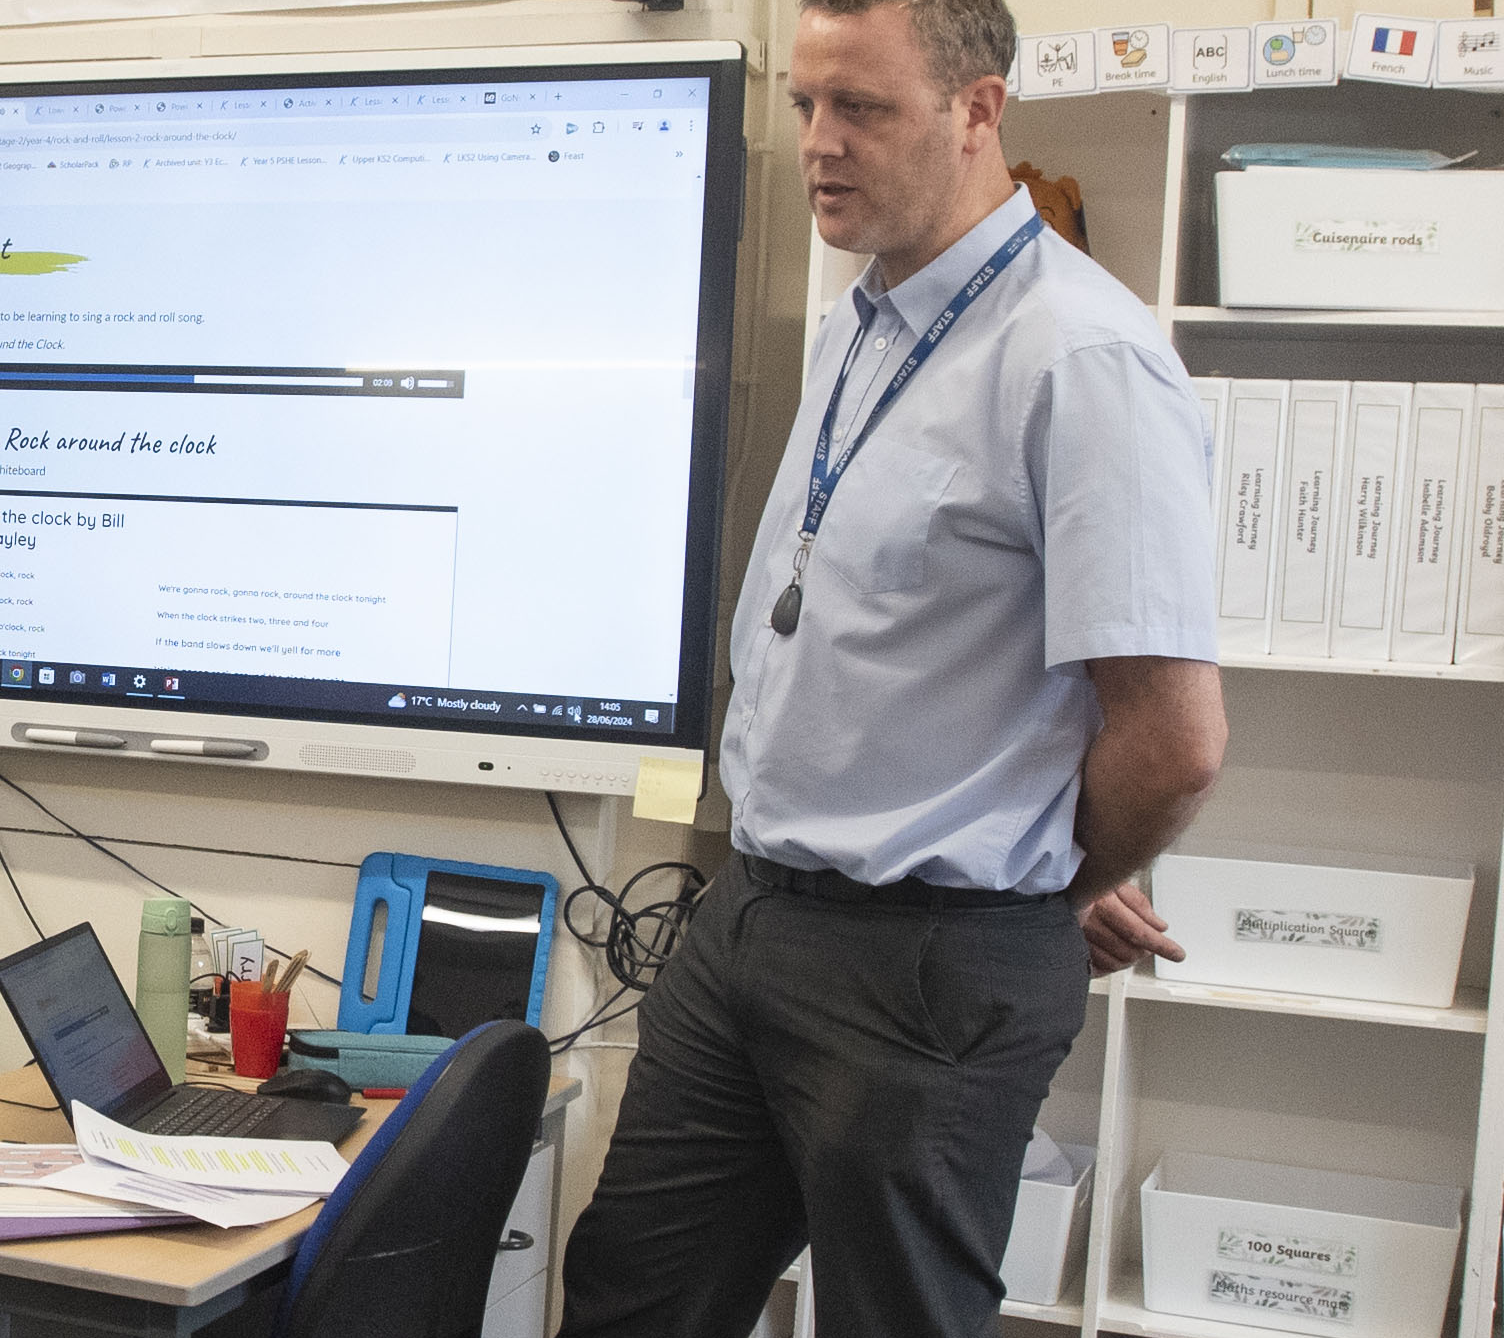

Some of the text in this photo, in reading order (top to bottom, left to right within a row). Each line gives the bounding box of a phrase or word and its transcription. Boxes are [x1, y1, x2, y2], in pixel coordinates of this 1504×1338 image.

[1196, 47, 1225, 58] ABC
[1266, 67, 1321, 78] Lunch time
[1372, 62, 1406, 75] French
[1464, 65, 1494, 76] Music
[1105, 69, 1156, 82] Break time
[1192, 73, 1227, 84] English
[1052, 78, 1063, 87] PE
[1312, 231, 1423, 246] Cuisenaire rods
[0, 312, 10, 322] to
[13, 311, 25, 322] be
[27, 311, 66, 324] learning
[69, 312, 80, 322] to
[82, 312, 102, 324] sing
[104, 314, 111, 322] a
[113, 312, 134, 322] rock
[138, 312, 156, 323] and
[159, 312, 175, 323] roll
[178, 315, 205, 325] song.
[18, 339, 34, 350] the
[36, 339, 65, 350] Clock.
[5, 428, 50, 451] Rock
[56, 432, 125, 453] around
[130, 432, 162, 454] the
[169, 434, 217, 455] clock
[2, 510, 26, 524] the
[32, 511, 71, 526] clock
[77, 512, 96, 530] by
[102, 513, 125, 528] Bill
[411, 696, 501, 712] 17°C Mostly cloudy
[600, 702, 620, 711] 14:05
[587, 715, 633, 726] 28/06/2024
[1247, 1241, 1331, 1262] 100 Squares
